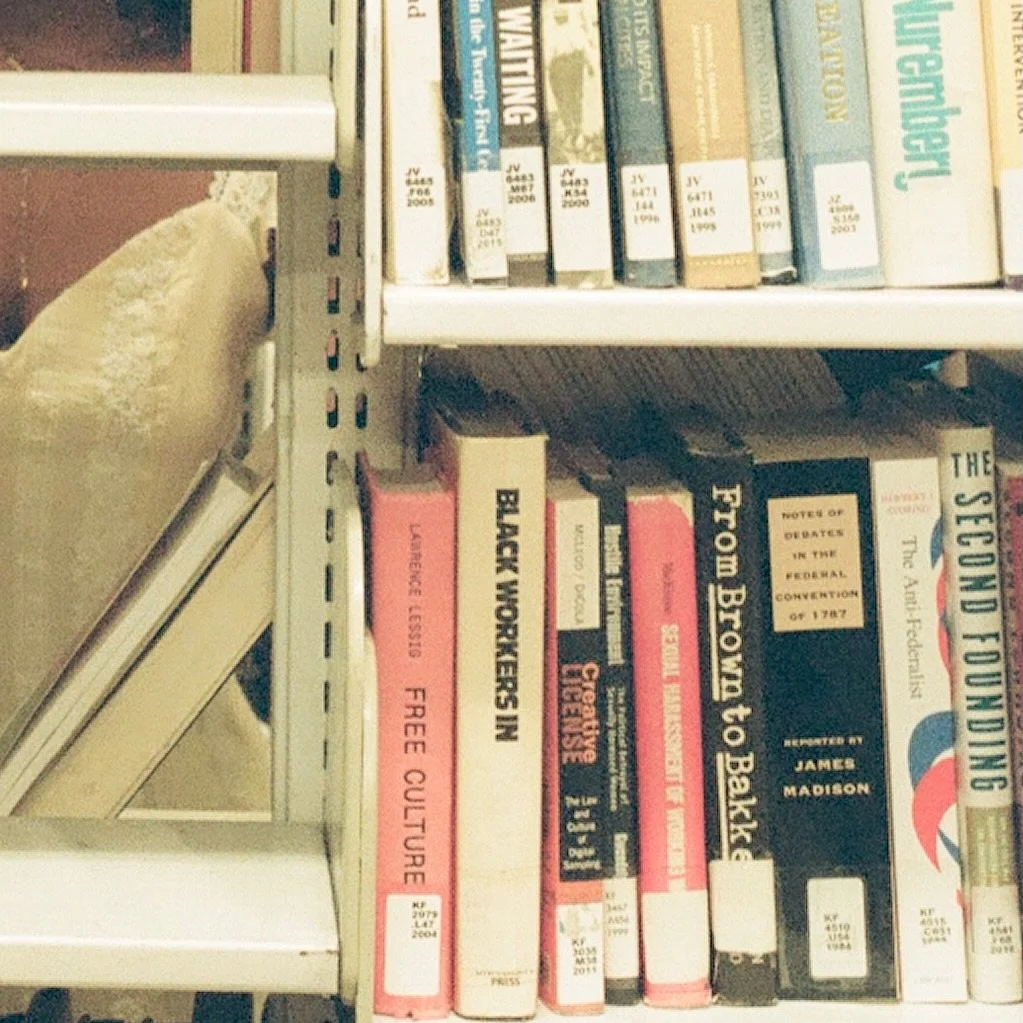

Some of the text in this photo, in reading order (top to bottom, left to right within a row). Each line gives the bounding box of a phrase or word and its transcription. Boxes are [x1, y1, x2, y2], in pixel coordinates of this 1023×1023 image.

[467, 17, 484, 44] the
[498, 5, 539, 127] WAITING
[781, 508, 845, 521] NOTES OF
[784, 528, 844, 541] DEBATES
[793, 549, 837, 561] IN THE
[785, 570, 847, 581] FEDERAL
[408, 524, 423, 660] LAWRENCE LESSIG
[775, 589, 859, 603] CONVENTION
[495, 488, 520, 742] BLACK WORKERS IN
[789, 609, 848, 622] OF 1787
[902, 536, 923, 701] The Anti-Federalist
[951, 450, 1008, 792] THE SECOND FOUNDING
[712, 484, 759, 862] From Brown to Bakke
[580, 662, 601, 763] Creative
[783, 736, 864, 748] REPORTED BY
[794, 757, 856, 773] JAMES
[403, 687, 427, 885] FREE CULTURE
[783, 783, 871, 798] MADISON
[490, 976, 521, 987] PRESS
